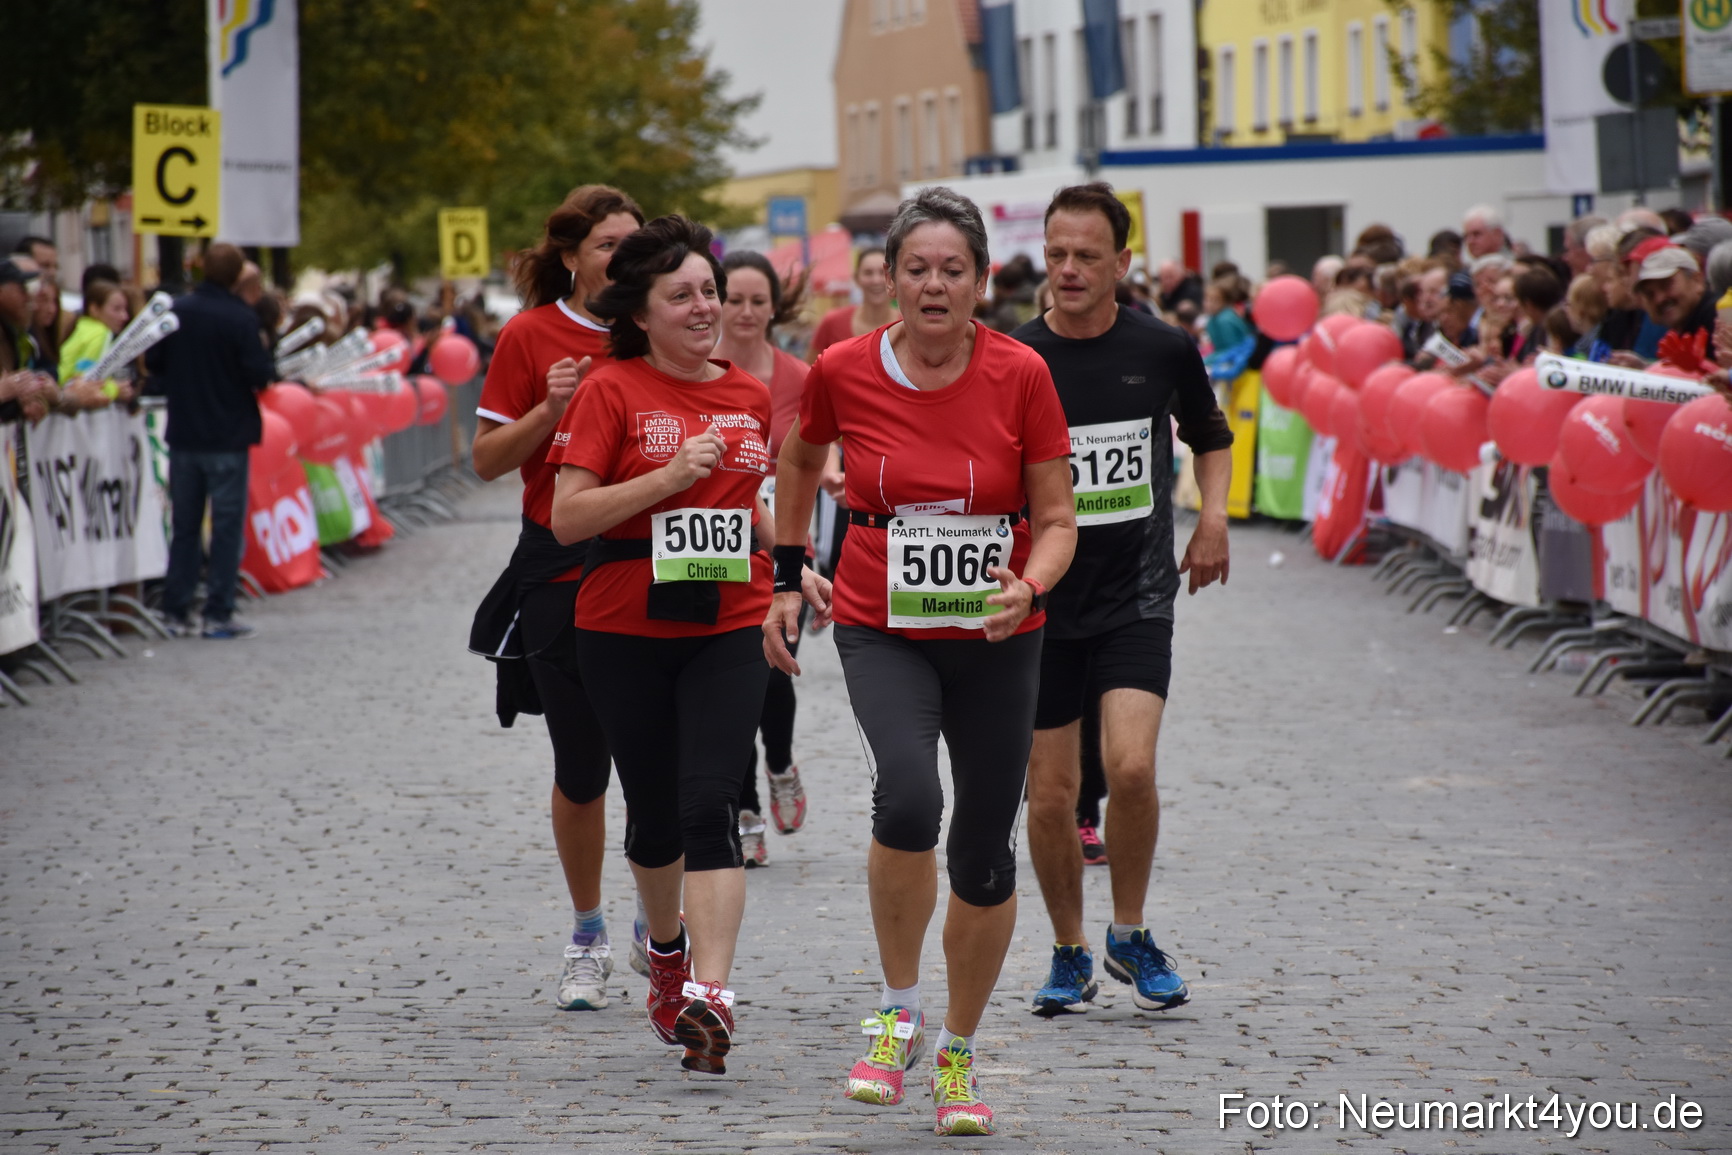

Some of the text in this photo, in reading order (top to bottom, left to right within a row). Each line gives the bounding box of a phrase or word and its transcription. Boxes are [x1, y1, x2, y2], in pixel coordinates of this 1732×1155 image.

[145, 112, 211, 136] Block
[155, 145, 197, 206] C
[453, 230, 477, 263] D
[1578, 376, 1625, 395] BMW
[645, 418, 679, 427] IMMER
[699, 414, 711, 422] 11.
[644, 426, 681, 434] WIEDER
[646, 434, 679, 445] NEU
[1086, 431, 1136, 446] Neumarkt
[645, 445, 679, 453] MARKT
[1077, 495, 1131, 512] Andreas
[665, 513, 743, 553] 5063
[891, 526, 992, 538] PARTL Neumarkt
[687, 562, 728, 579] Christa
[902, 543, 1002, 587] 5066
[922, 598, 983, 614] Martina
